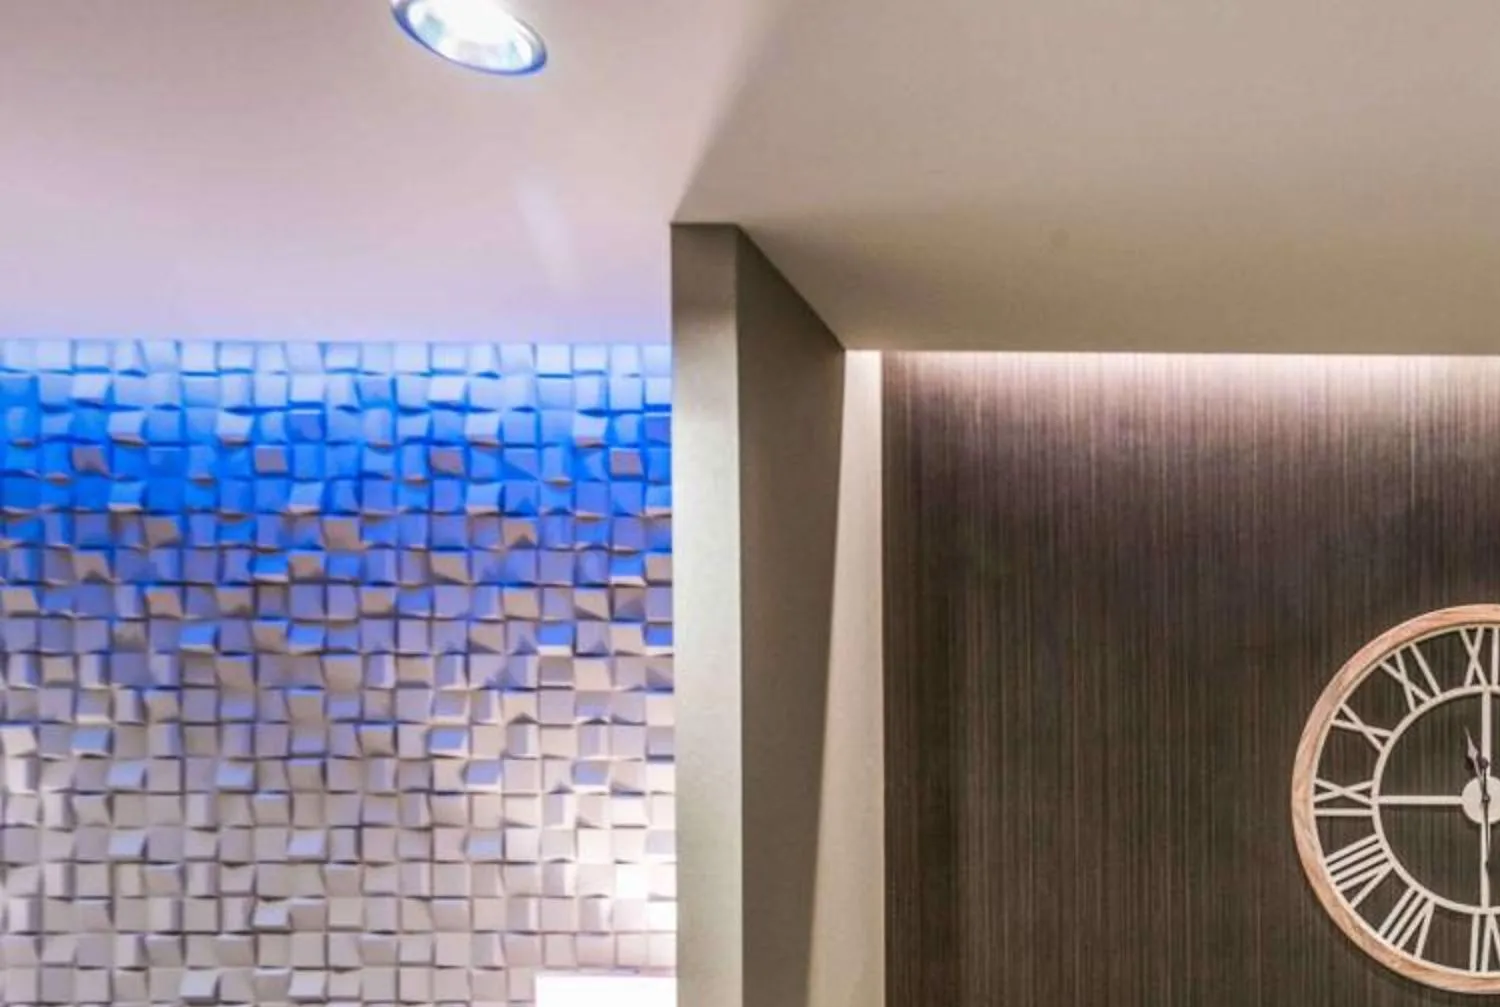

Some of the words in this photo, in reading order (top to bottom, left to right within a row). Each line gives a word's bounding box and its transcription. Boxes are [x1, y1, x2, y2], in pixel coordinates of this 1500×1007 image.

[1380, 641, 1441, 712] XI
[1330, 702, 1394, 752] X
[1313, 777, 1374, 817] IX
